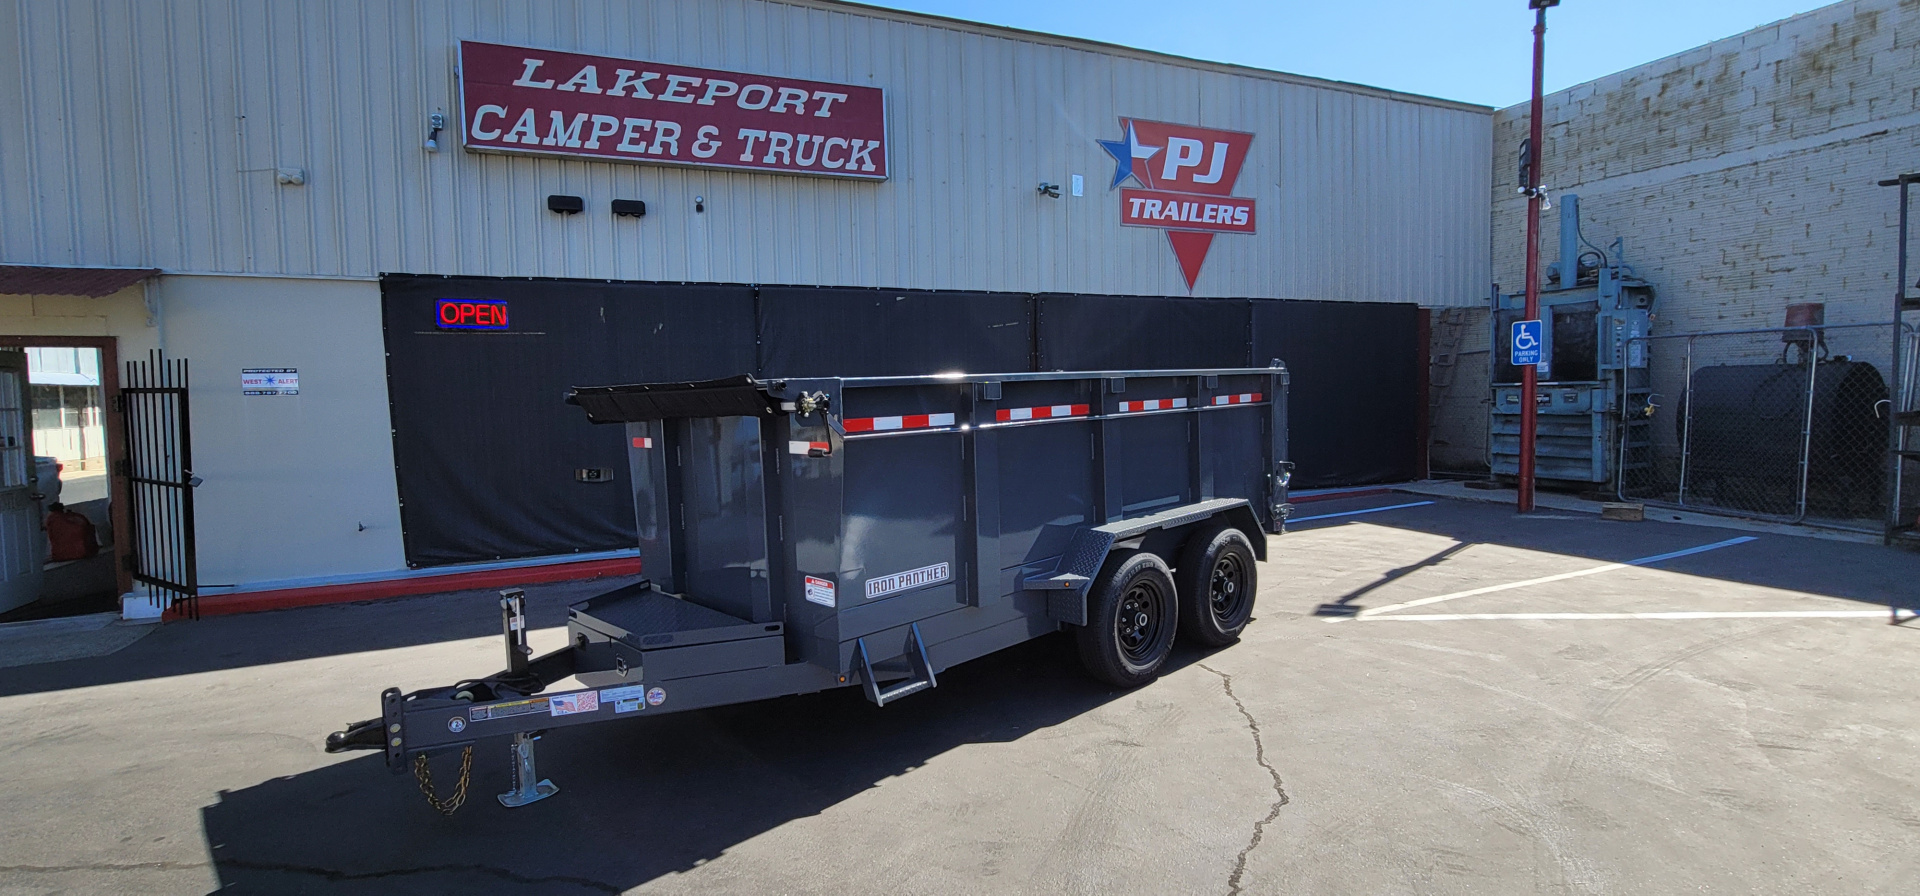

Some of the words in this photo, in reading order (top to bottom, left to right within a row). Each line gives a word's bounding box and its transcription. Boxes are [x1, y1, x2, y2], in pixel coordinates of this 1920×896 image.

[512, 58, 847, 118] LAKEPORT
[471, 104, 682, 156] CAMPER
[691, 125, 722, 158] &
[738, 128, 880, 172] TRUCK
[1161, 136, 1229, 184] PJ
[1129, 197, 1249, 226] TRAILERS
[440, 303, 506, 325] OPEN
[868, 577, 896, 595] IRON
[899, 565, 947, 588] PANTHER
